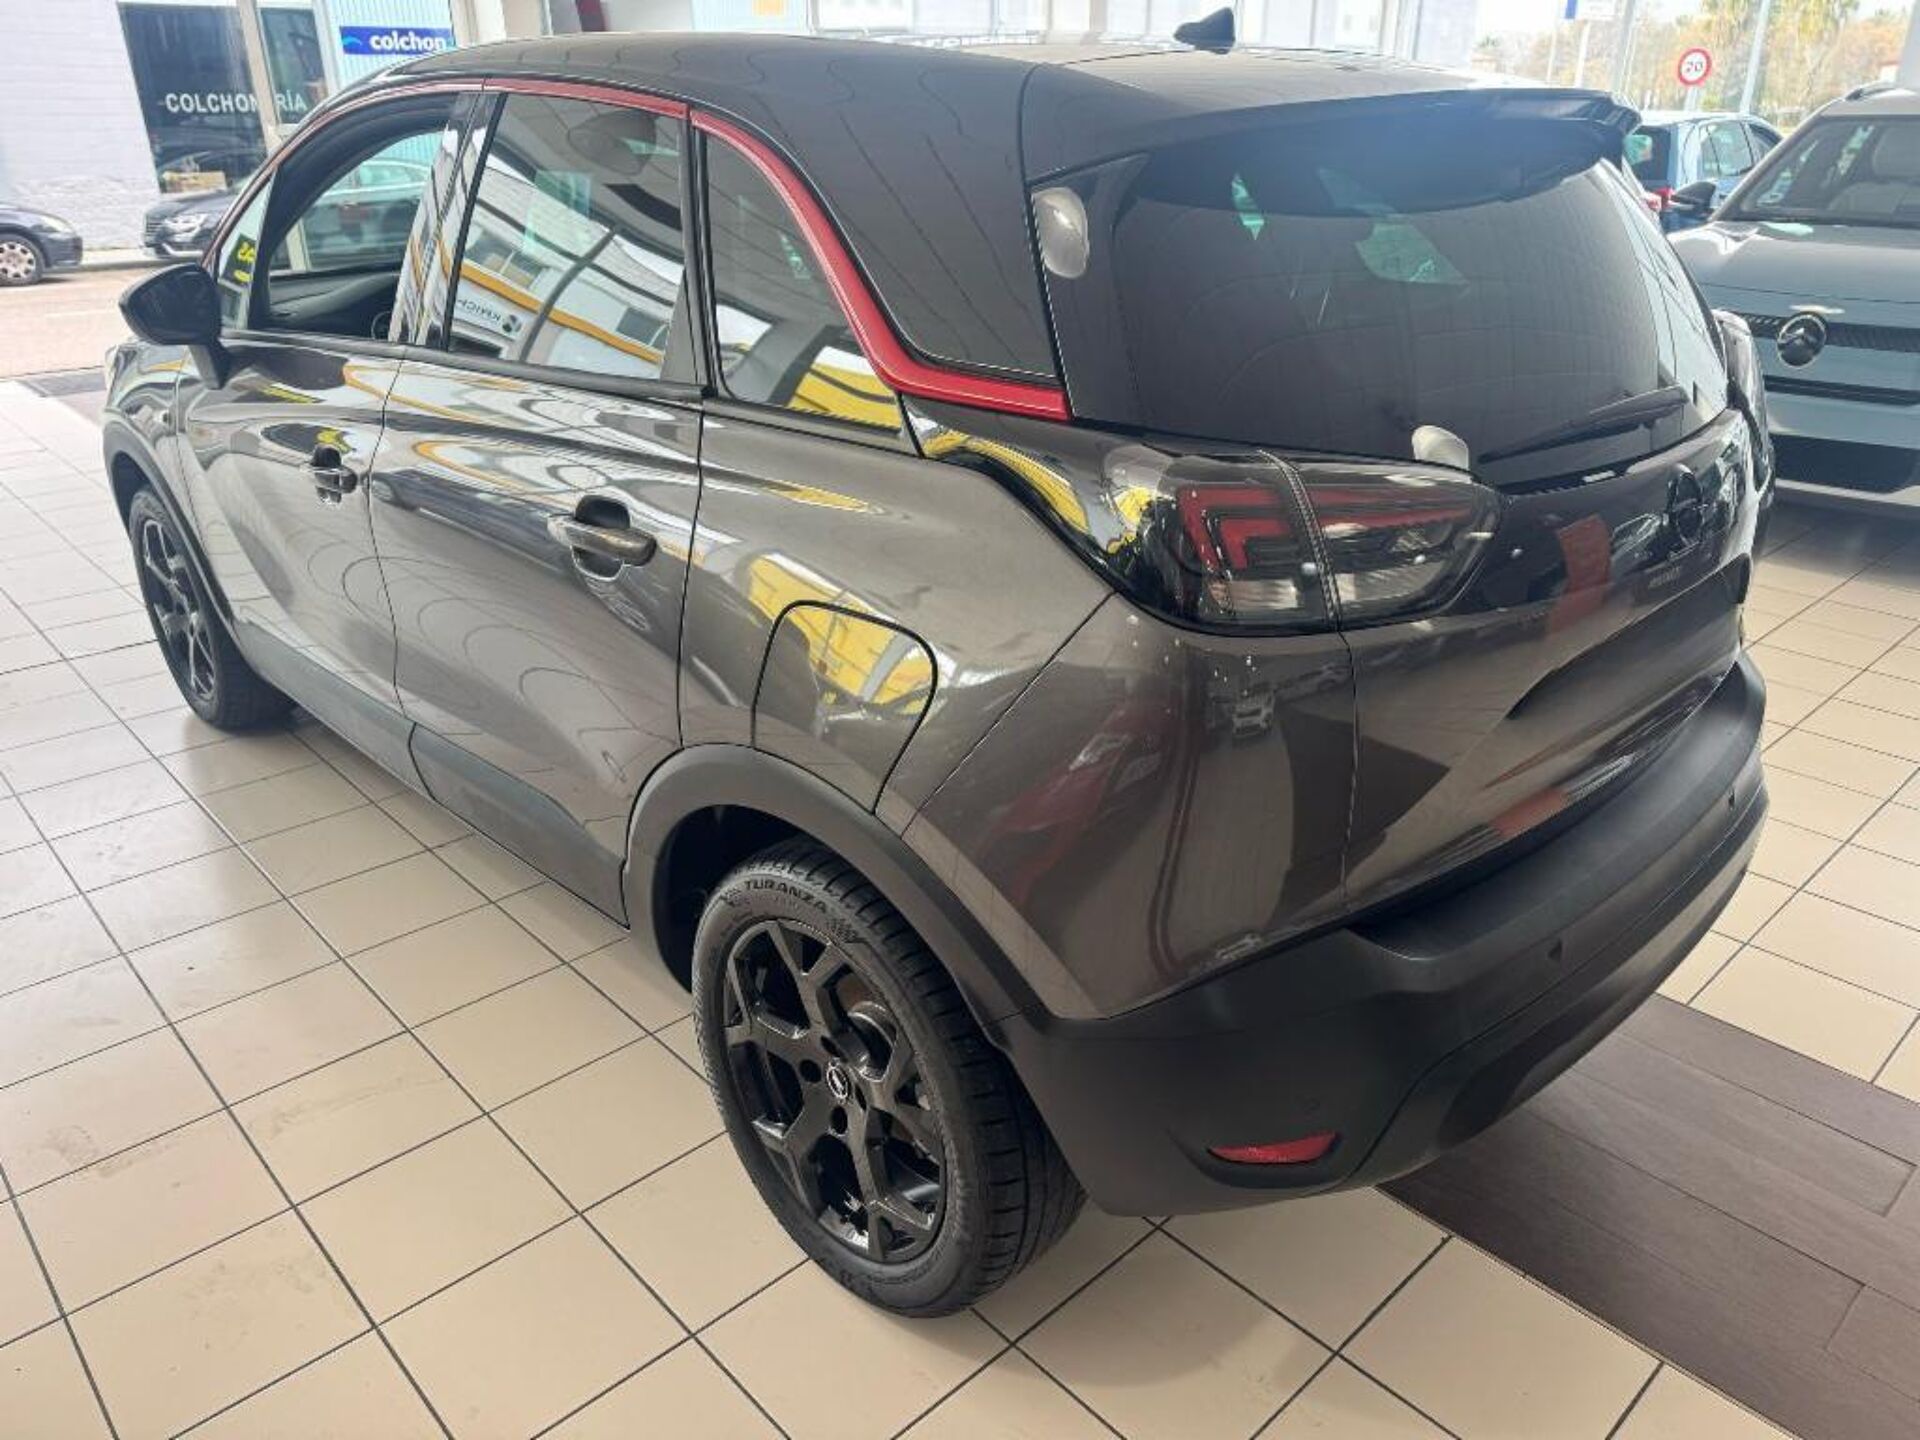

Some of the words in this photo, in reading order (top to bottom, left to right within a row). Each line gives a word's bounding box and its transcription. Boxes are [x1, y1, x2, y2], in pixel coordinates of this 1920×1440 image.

[369, 30, 447, 51] colchon
[165, 89, 308, 113] COLCHONRÍA
[744, 879, 827, 914] TURANZA
